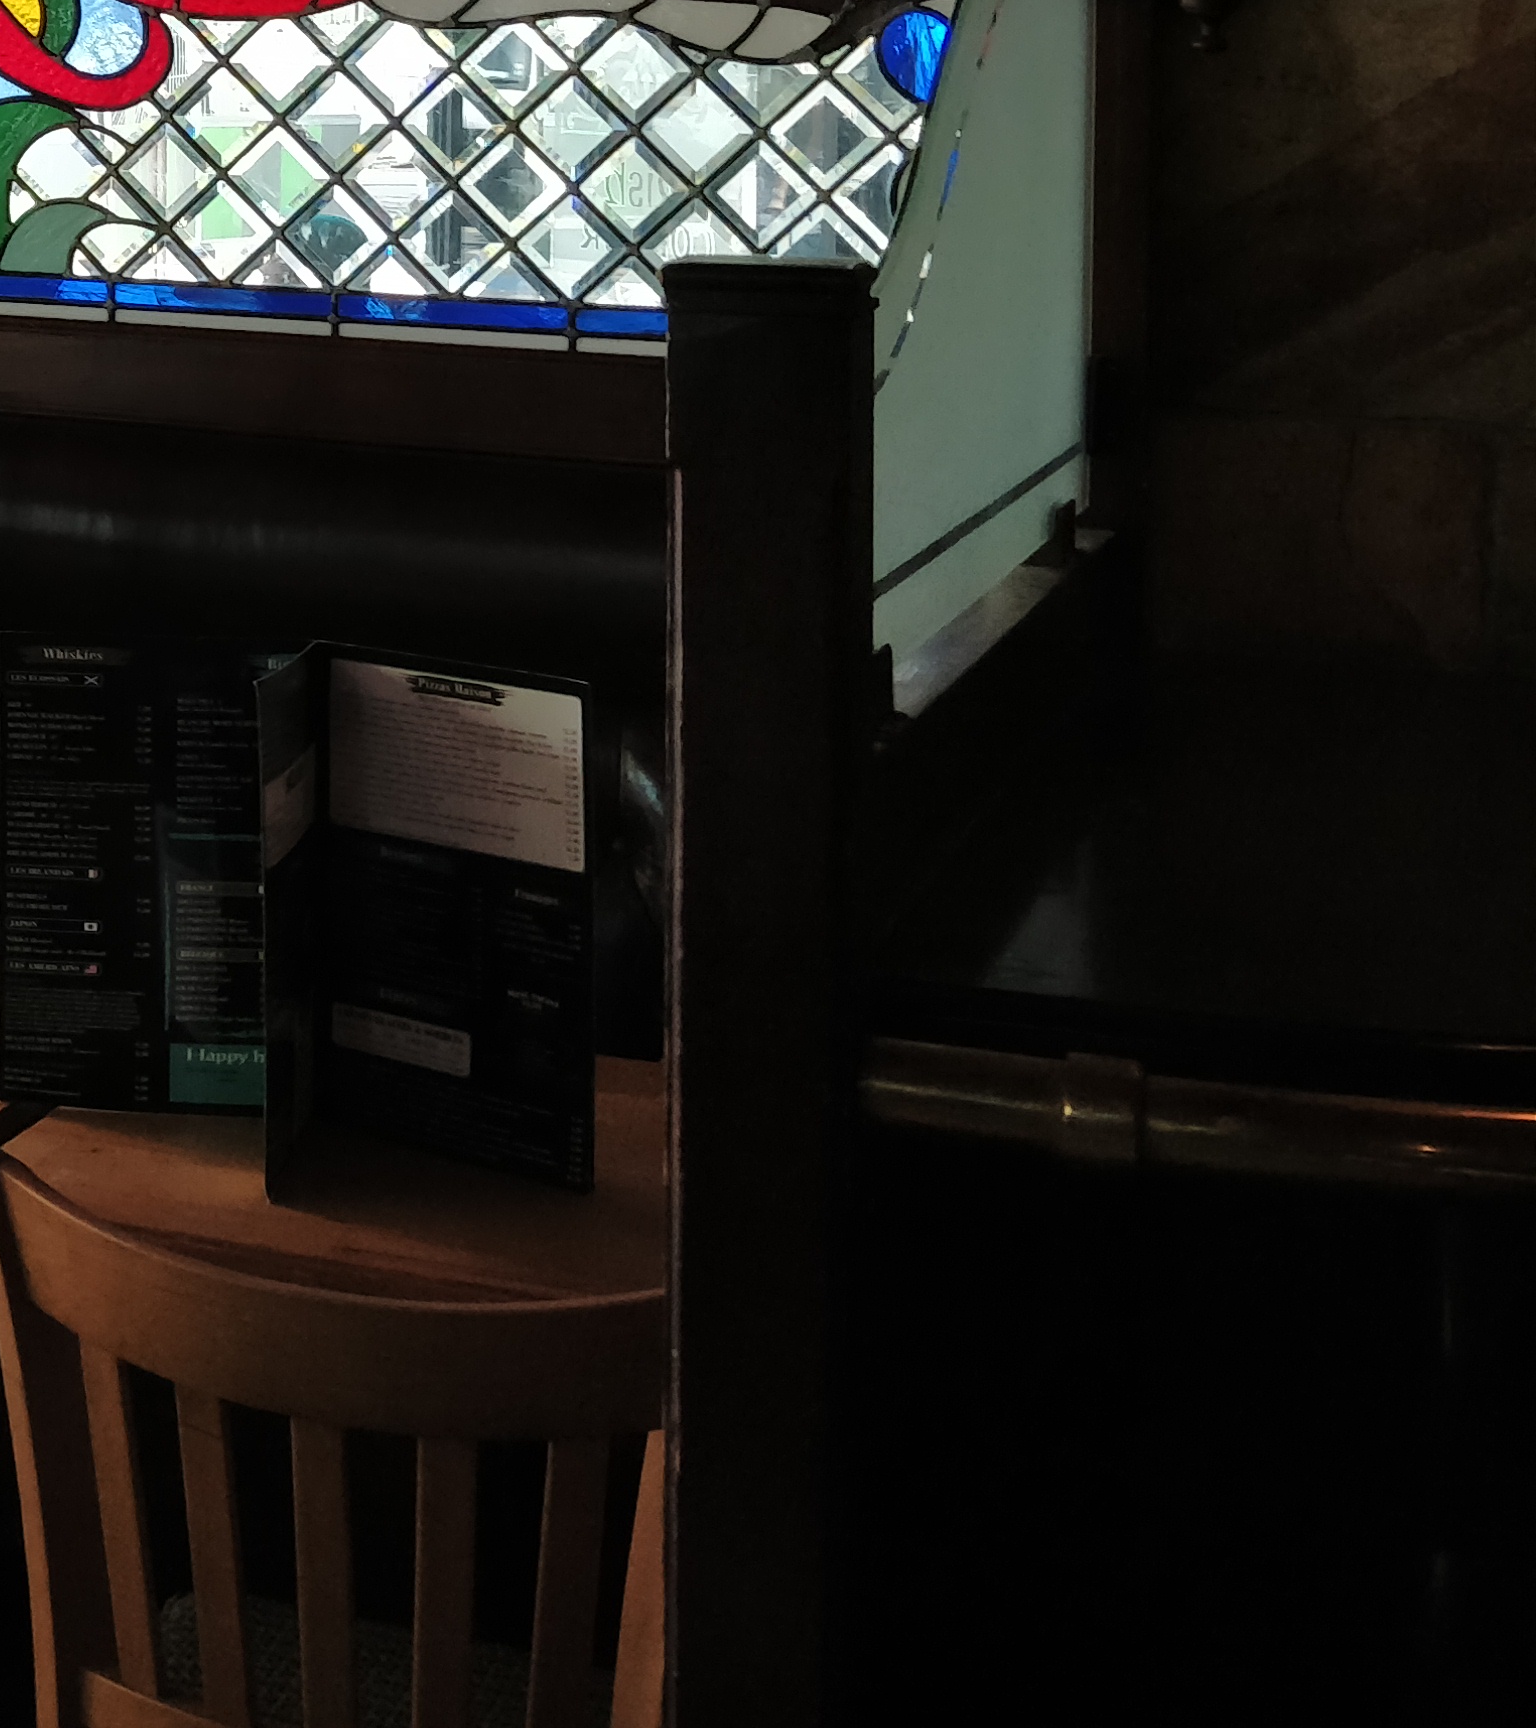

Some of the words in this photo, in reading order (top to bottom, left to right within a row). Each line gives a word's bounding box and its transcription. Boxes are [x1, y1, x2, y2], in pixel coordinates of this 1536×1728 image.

[42, 647, 104, 662] Whiskies
[417, 677, 451, 694] Pizzas
[186, 1047, 250, 1065] Happy
